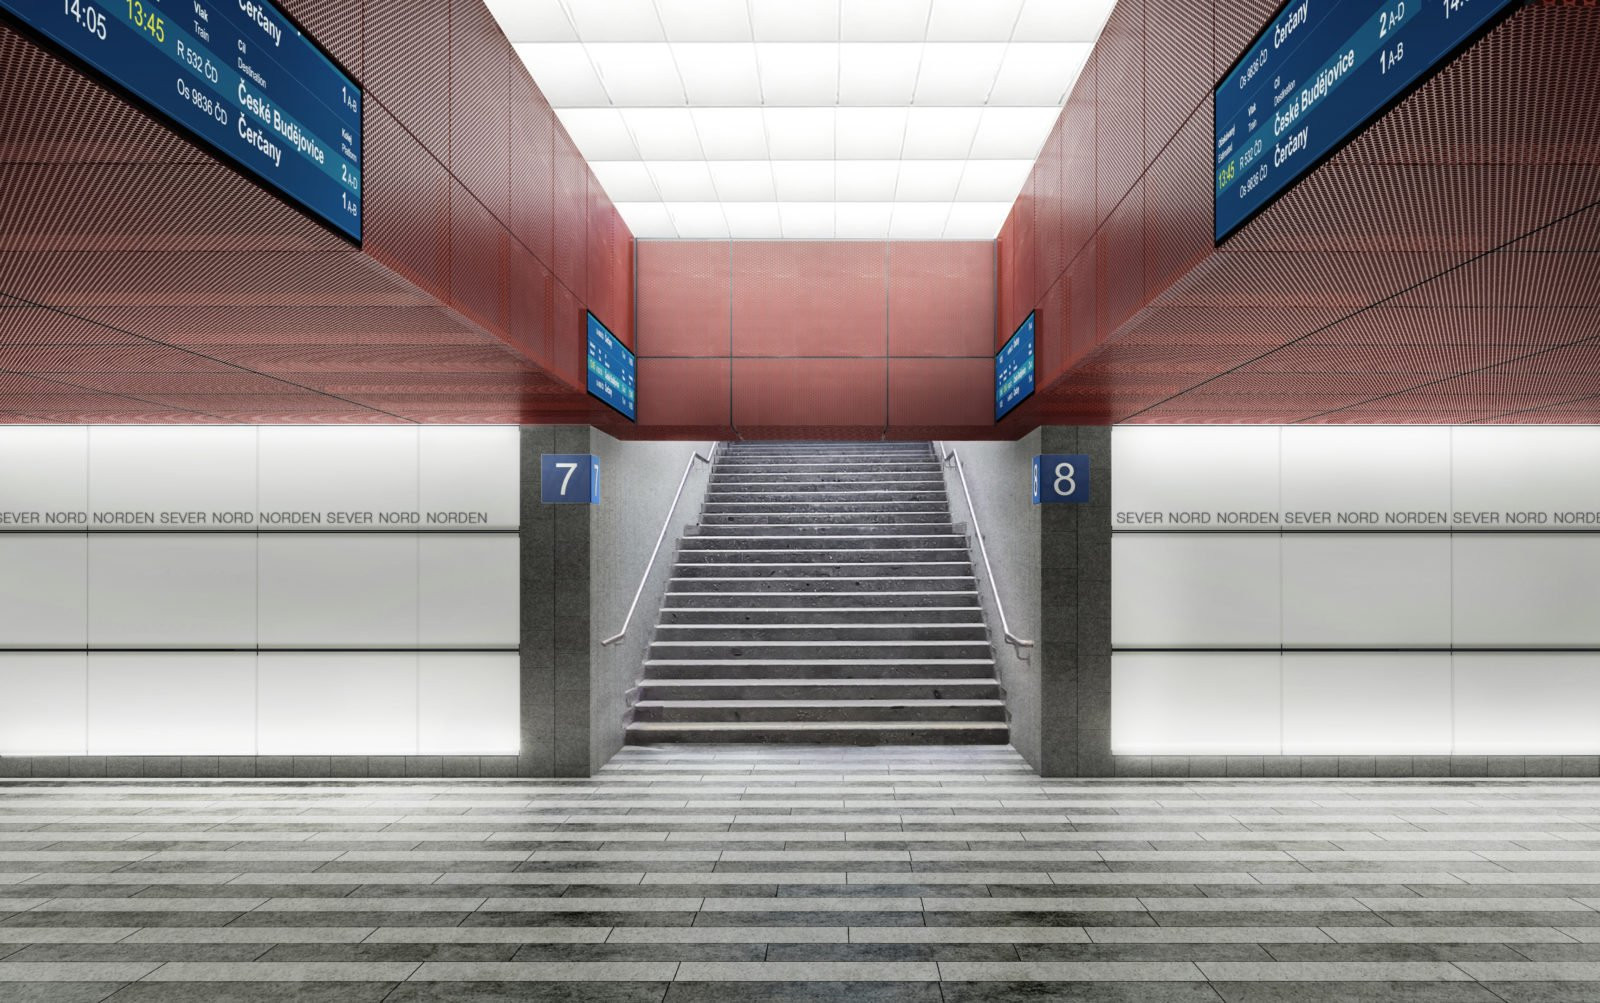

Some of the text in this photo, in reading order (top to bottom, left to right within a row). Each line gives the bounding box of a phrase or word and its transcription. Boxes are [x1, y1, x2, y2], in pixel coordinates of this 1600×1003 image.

[64, 0, 107, 40] 14:05
[122, 0, 165, 42] 13:45
[1379, 1, 1405, 38] 2 A-D
[177, 40, 218, 84] R 532 ČD
[1379, 41, 1404, 74] 1 A-B
[176, 77, 228, 126] Os 9836 ČD
[342, 85, 347, 104] 1
[1274, 97, 1300, 137] České
[1301, 49, 1355, 112] Budějovice
[237, 111, 282, 168] Čerčany
[238, 77, 325, 165] České Budějovice
[1274, 126, 1309, 168] Čerčany
[341, 163, 347, 182] 2
[342, 191, 347, 210] 1
[555, 462, 578, 496] 7
[1053, 462, 1076, 496] 8
[0, 511, 488, 524] EVER NORD NORDEN SEVER NORD NORDEN SEVER NORD NORDEN
[1116, 511, 1163, 524] SEVER
[1168, 511, 1211, 524] NORD
[1217, 511, 1279, 524] NORDEN
[1284, 511, 1331, 524] SEVER
[1337, 511, 1379, 524] NORD
[1385, 511, 1447, 524] NORDEN
[1452, 511, 1500, 524] SEVER
[1505, 511, 1548, 524] NORD
